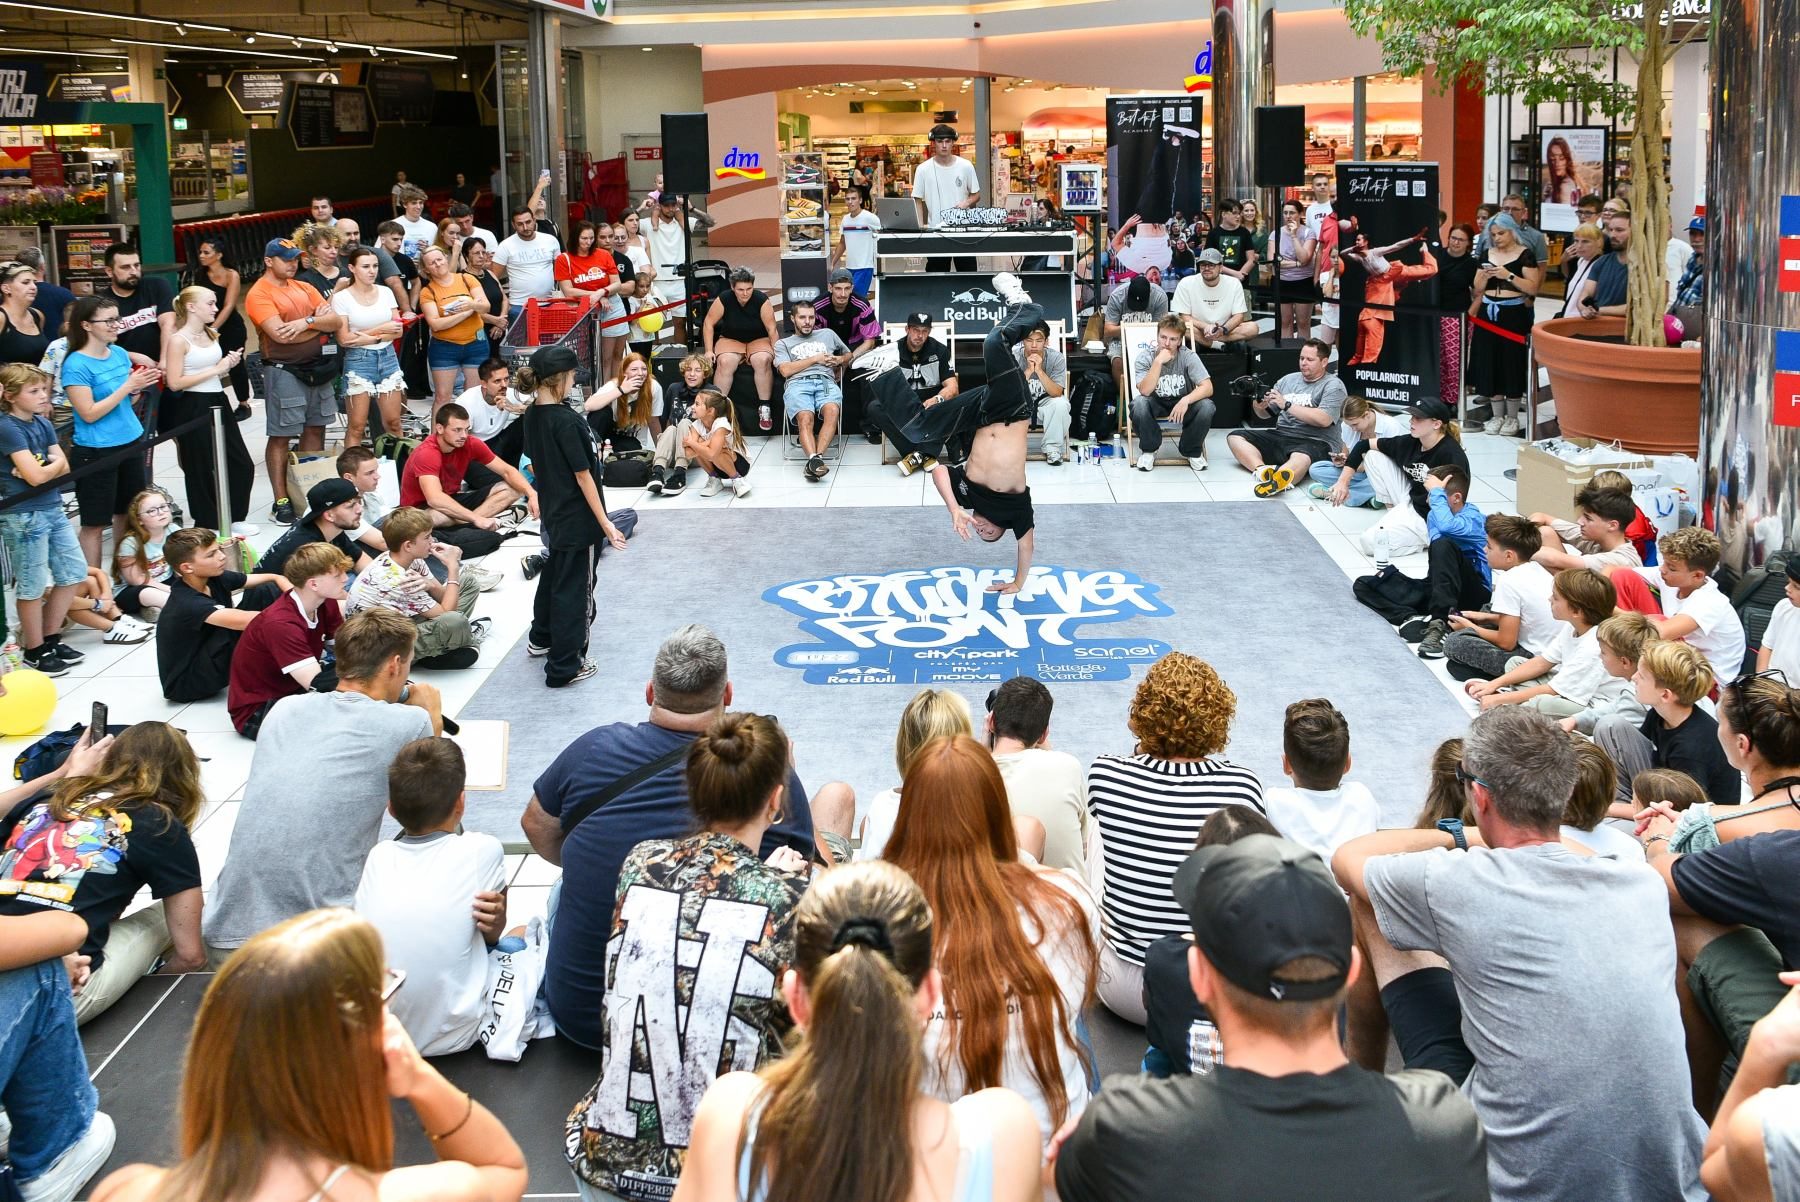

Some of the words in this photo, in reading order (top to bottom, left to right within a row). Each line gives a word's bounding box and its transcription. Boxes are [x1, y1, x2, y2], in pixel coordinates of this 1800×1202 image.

[1194, 41, 1212, 76] d
[724, 147, 760, 168] dm
[791, 290, 817, 298] BUZZ
[944, 306, 975, 321] Red
[976, 306, 1007, 321] Bull
[1355, 369, 1410, 385] POPULARNOST
[1411, 374, 1420, 386] NI
[1365, 387, 1410, 402] NAKLJUČJE!
[1037, 663, 1106, 673] Bottega
[1039, 671, 1094, 680] Verde
[827, 675, 862, 684] Red
[864, 675, 897, 684] Bull
[620, 1177, 677, 1196] DIFFEREN
